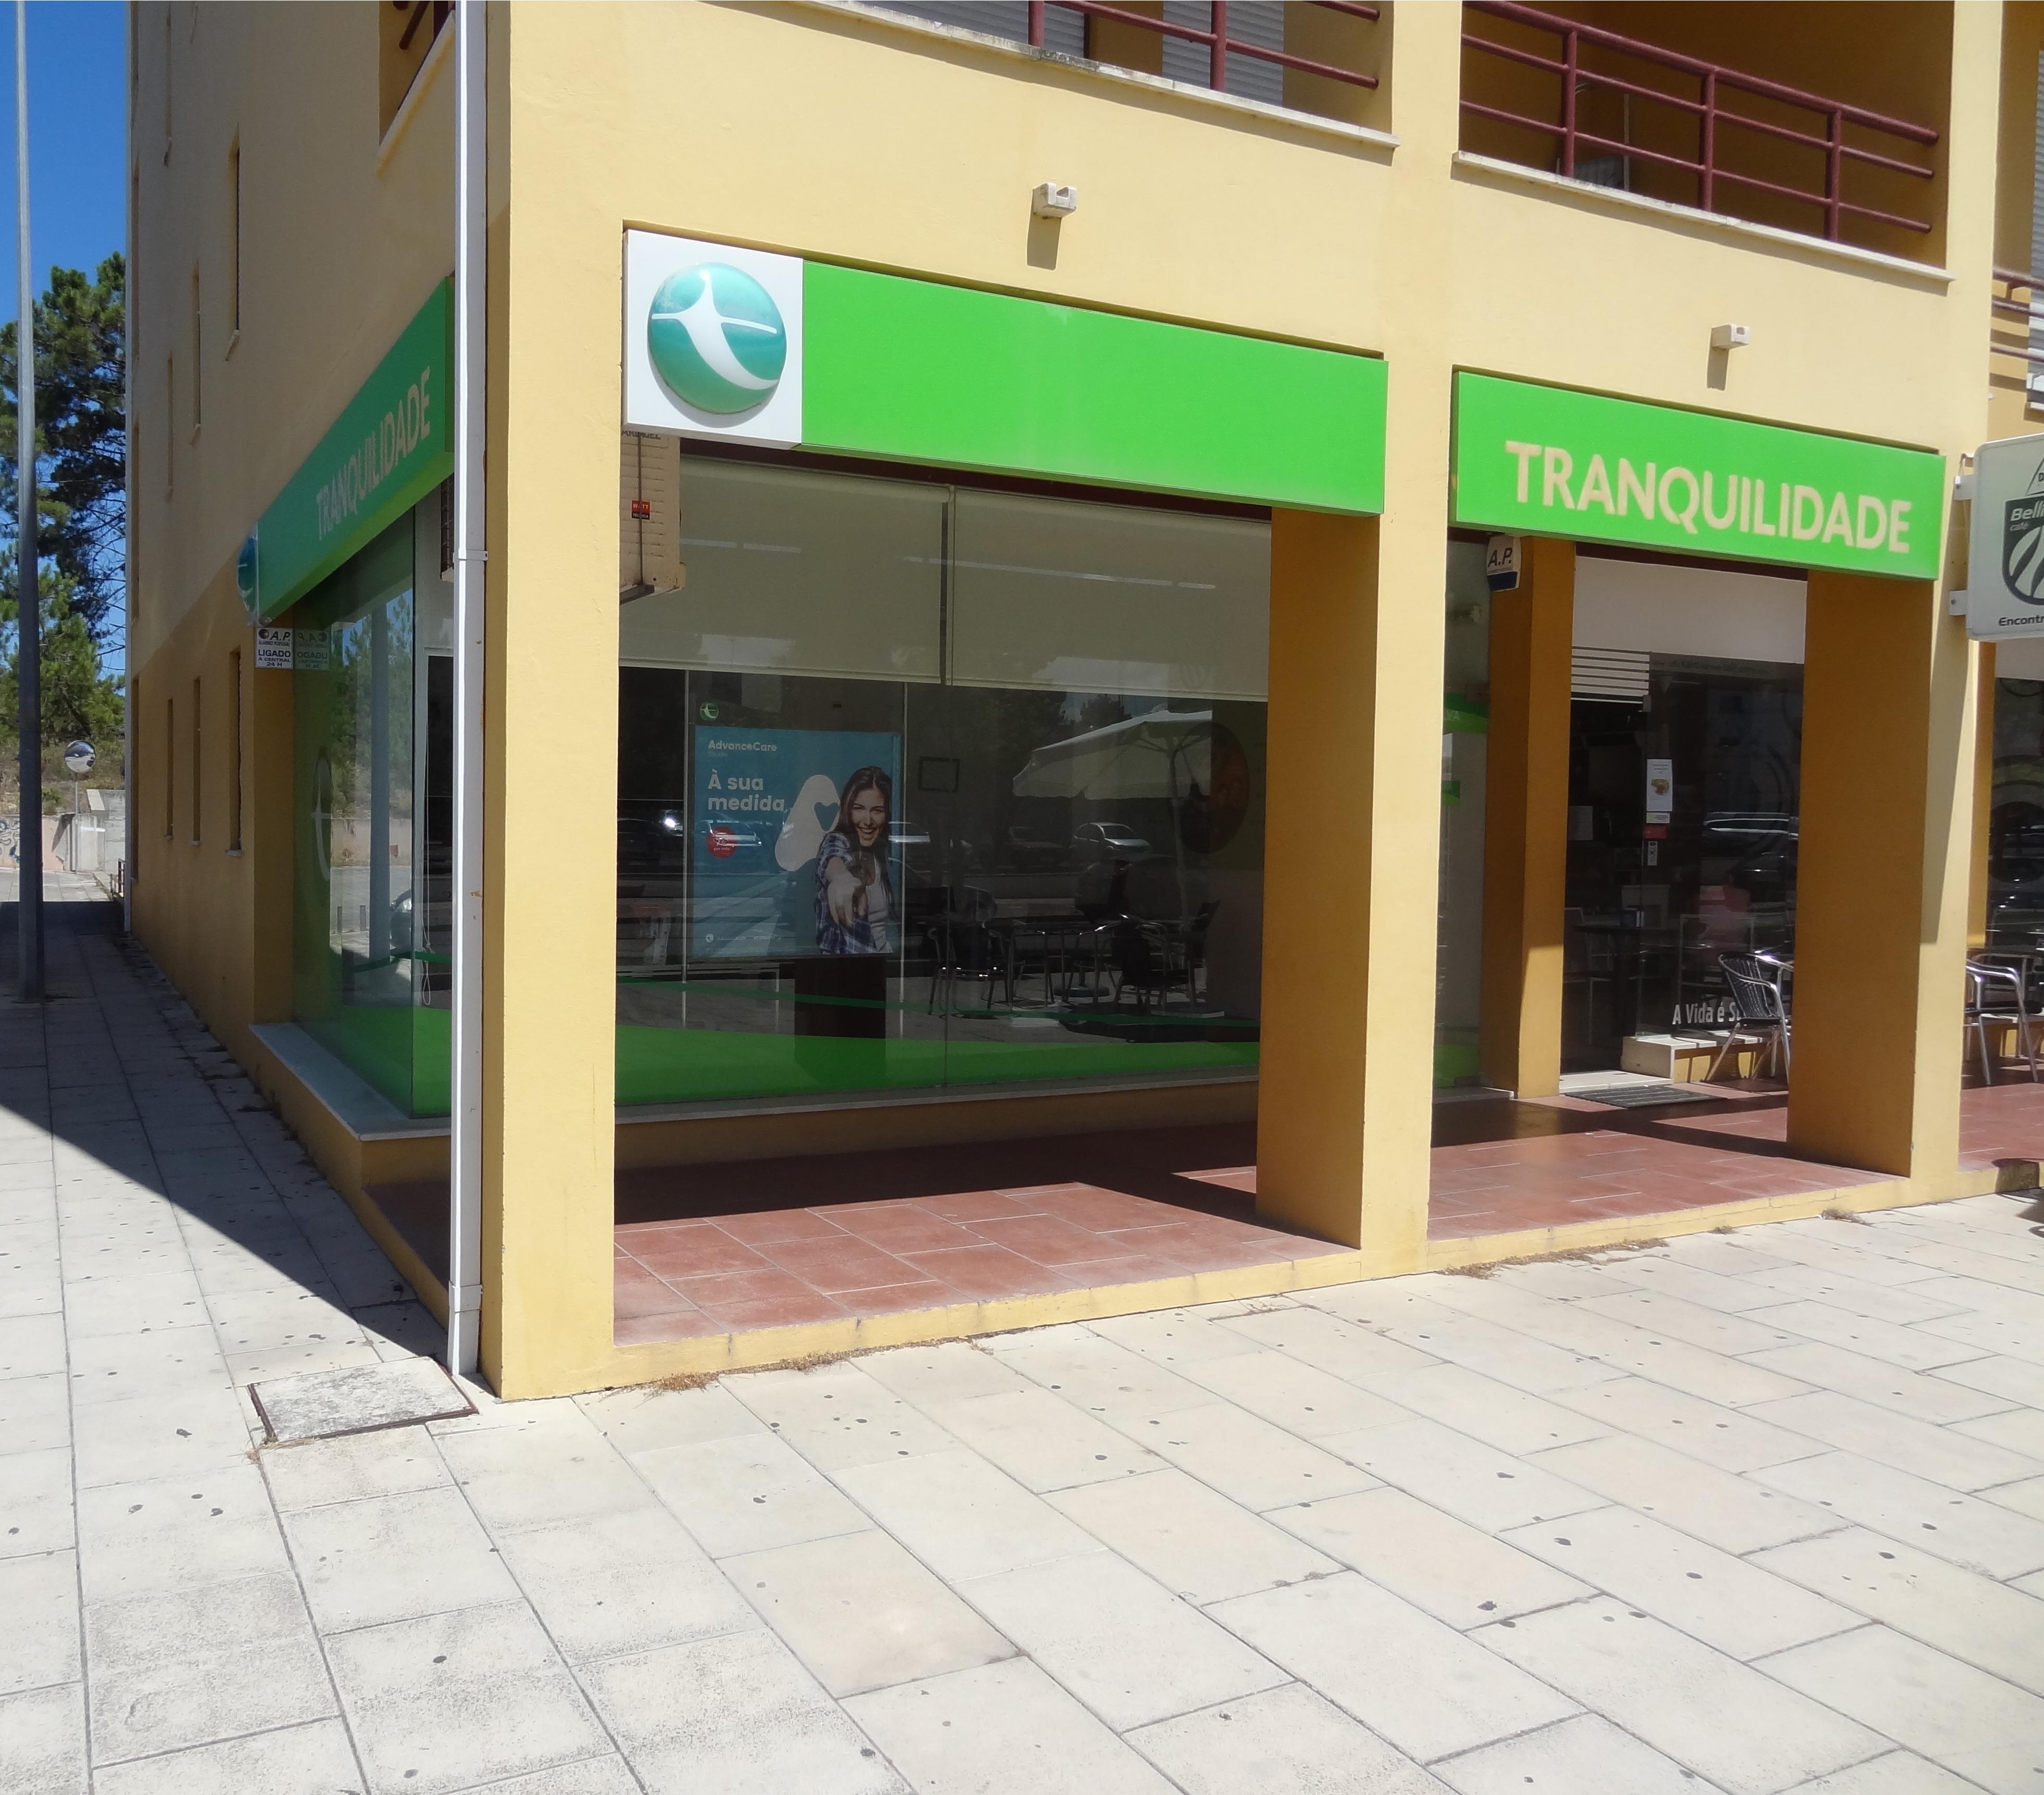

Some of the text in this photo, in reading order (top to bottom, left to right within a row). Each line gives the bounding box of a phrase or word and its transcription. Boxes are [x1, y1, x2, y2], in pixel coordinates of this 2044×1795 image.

[1505, 440, 1912, 553] TRANQUILIDADE
[1487, 548, 1513, 567] A.P.
[270, 631, 291, 641] A.P.
[708, 740, 777, 752] AdvanceCare
[708, 769, 763, 791] À sua
[1672, 1004, 1681, 1025] A
[1685, 1002, 1713, 1024] Vida
[1717, 1001, 1724, 1023] é
